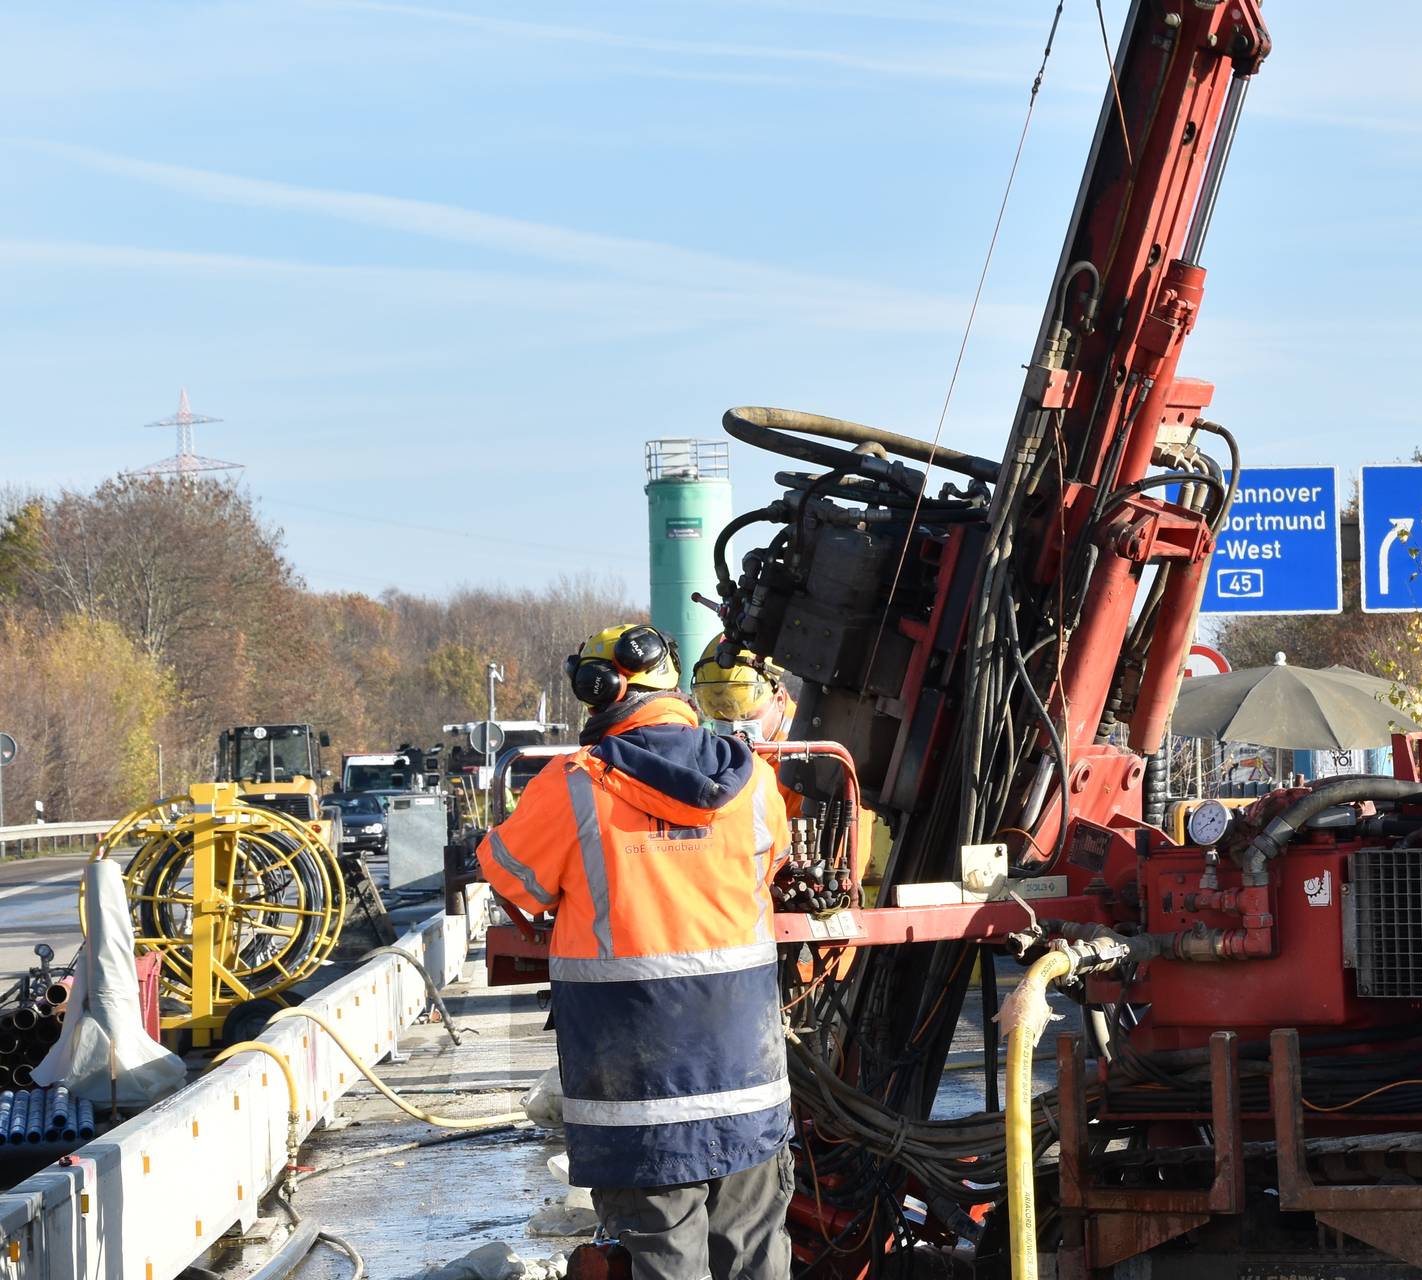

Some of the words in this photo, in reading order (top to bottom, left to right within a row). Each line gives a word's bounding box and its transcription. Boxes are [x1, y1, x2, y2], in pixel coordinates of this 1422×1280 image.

[1226, 485, 1322, 503] annover
[1216, 540, 1282, 560] -West
[1229, 575, 1252, 592] 45
[625, 844, 646, 855] GbE
